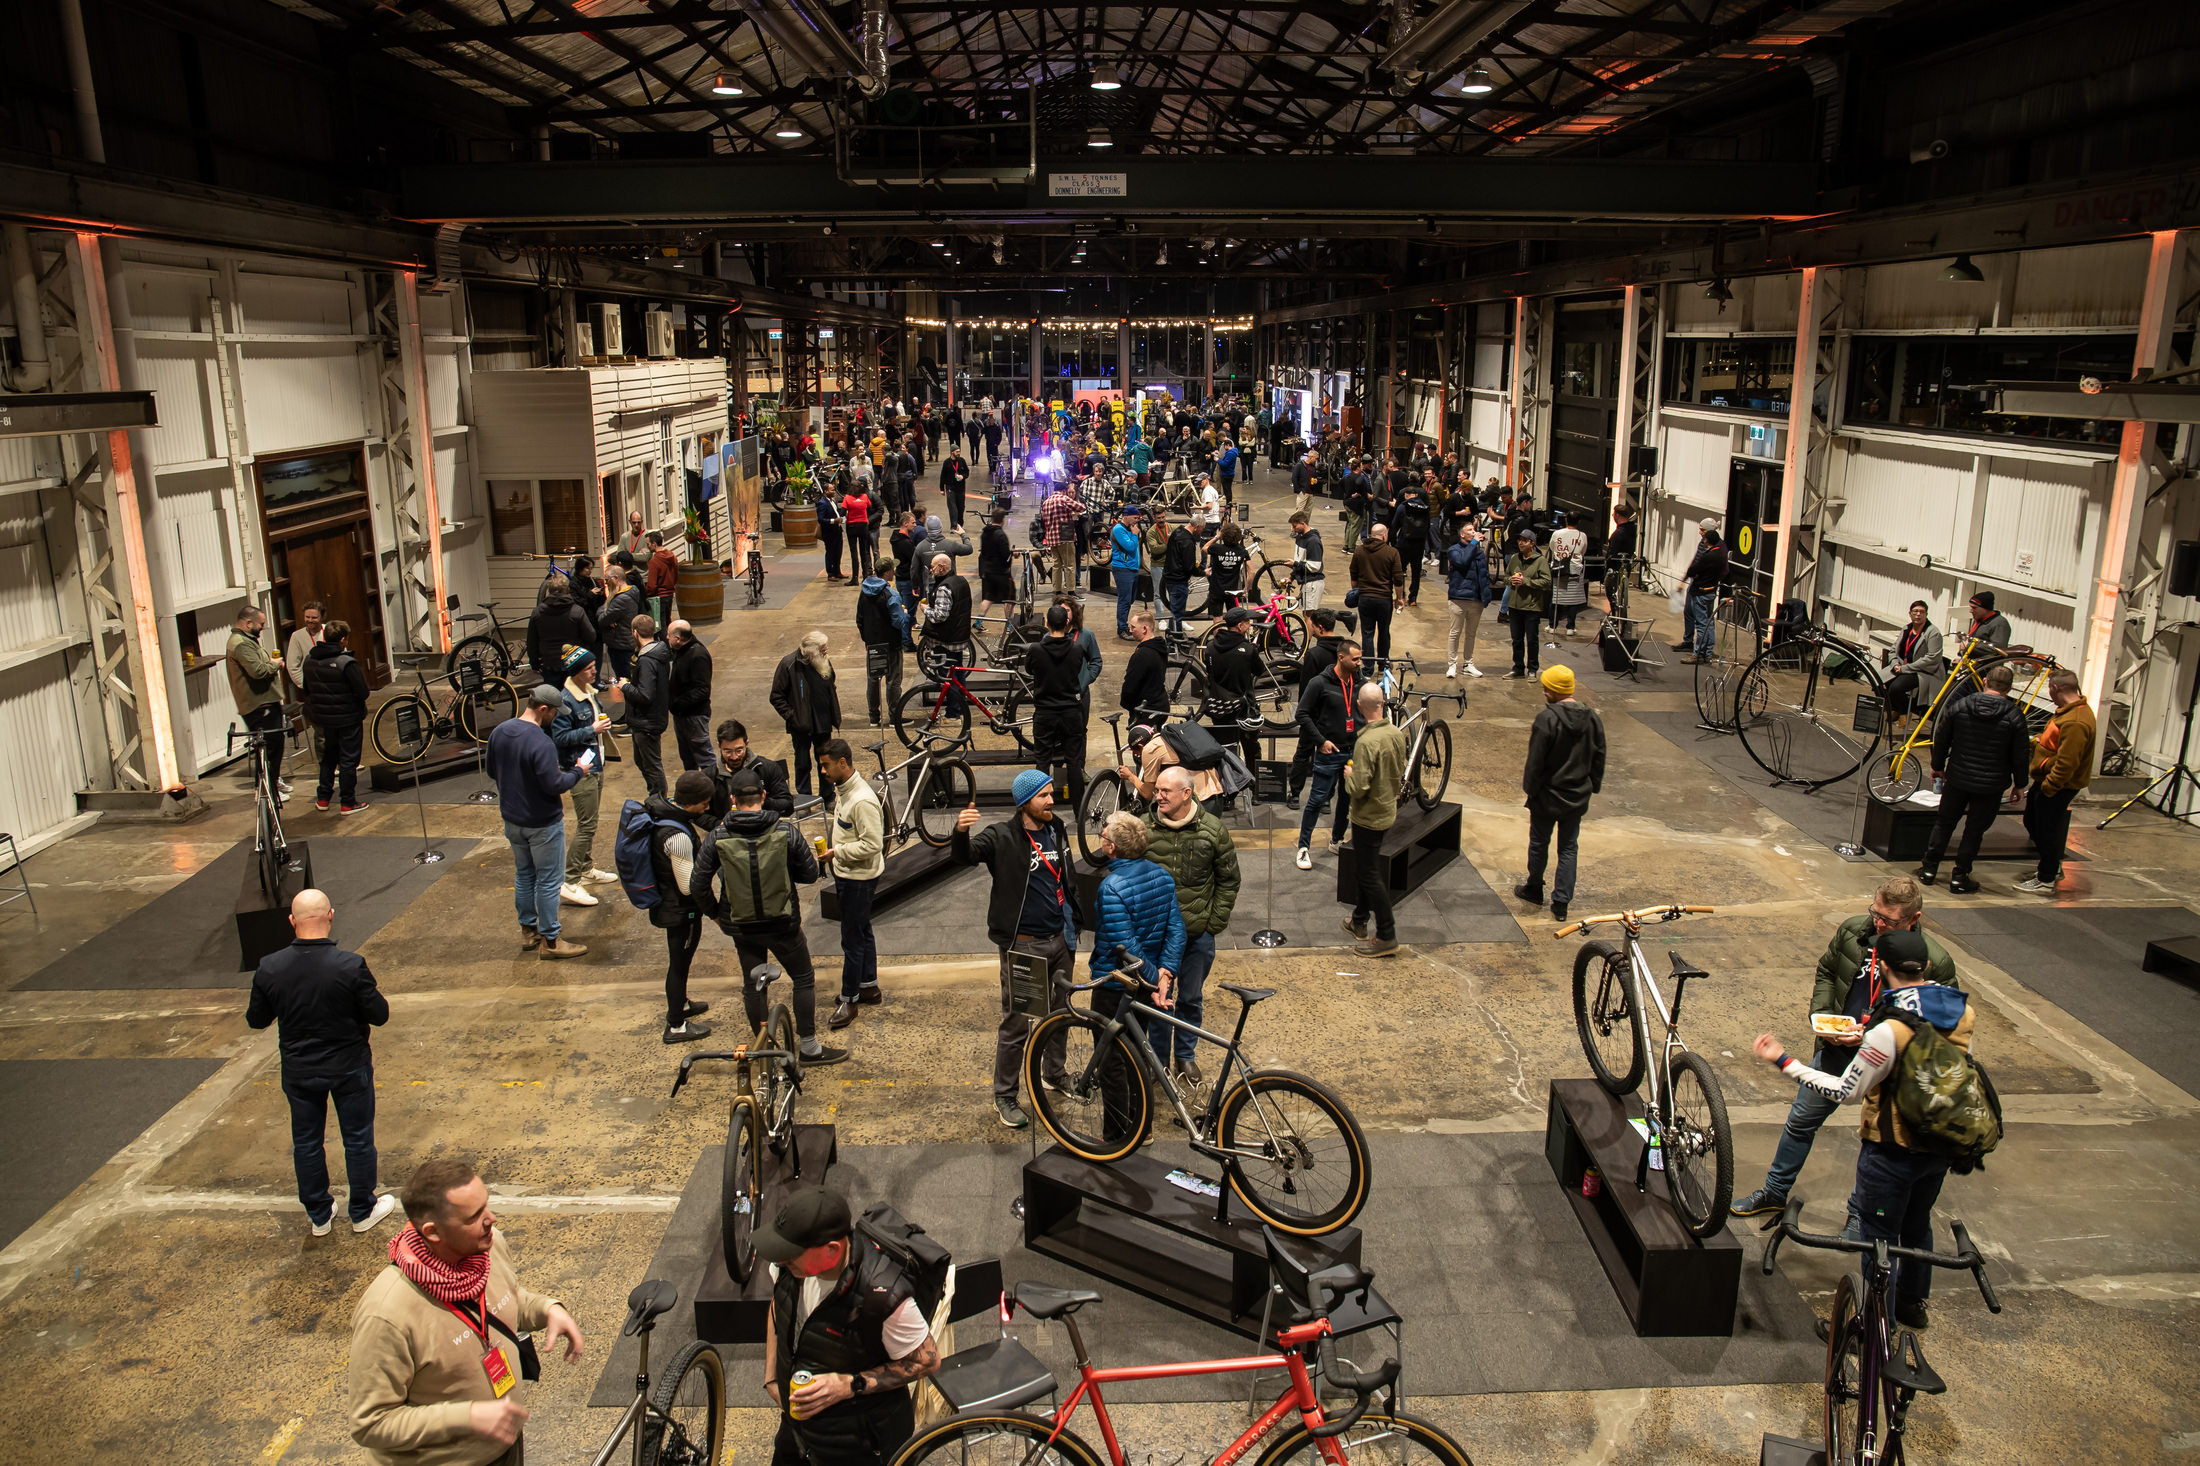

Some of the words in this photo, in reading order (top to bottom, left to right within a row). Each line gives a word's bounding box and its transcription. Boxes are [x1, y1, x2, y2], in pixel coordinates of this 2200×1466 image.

[1082, 174, 1088, 182] 5
[1096, 180, 1101, 188] 3
[1055, 187, 1080, 195] DONNELLY
[1087, 187, 1121, 195] ENGINEERING
[2054, 187, 2167, 228] DANGER
